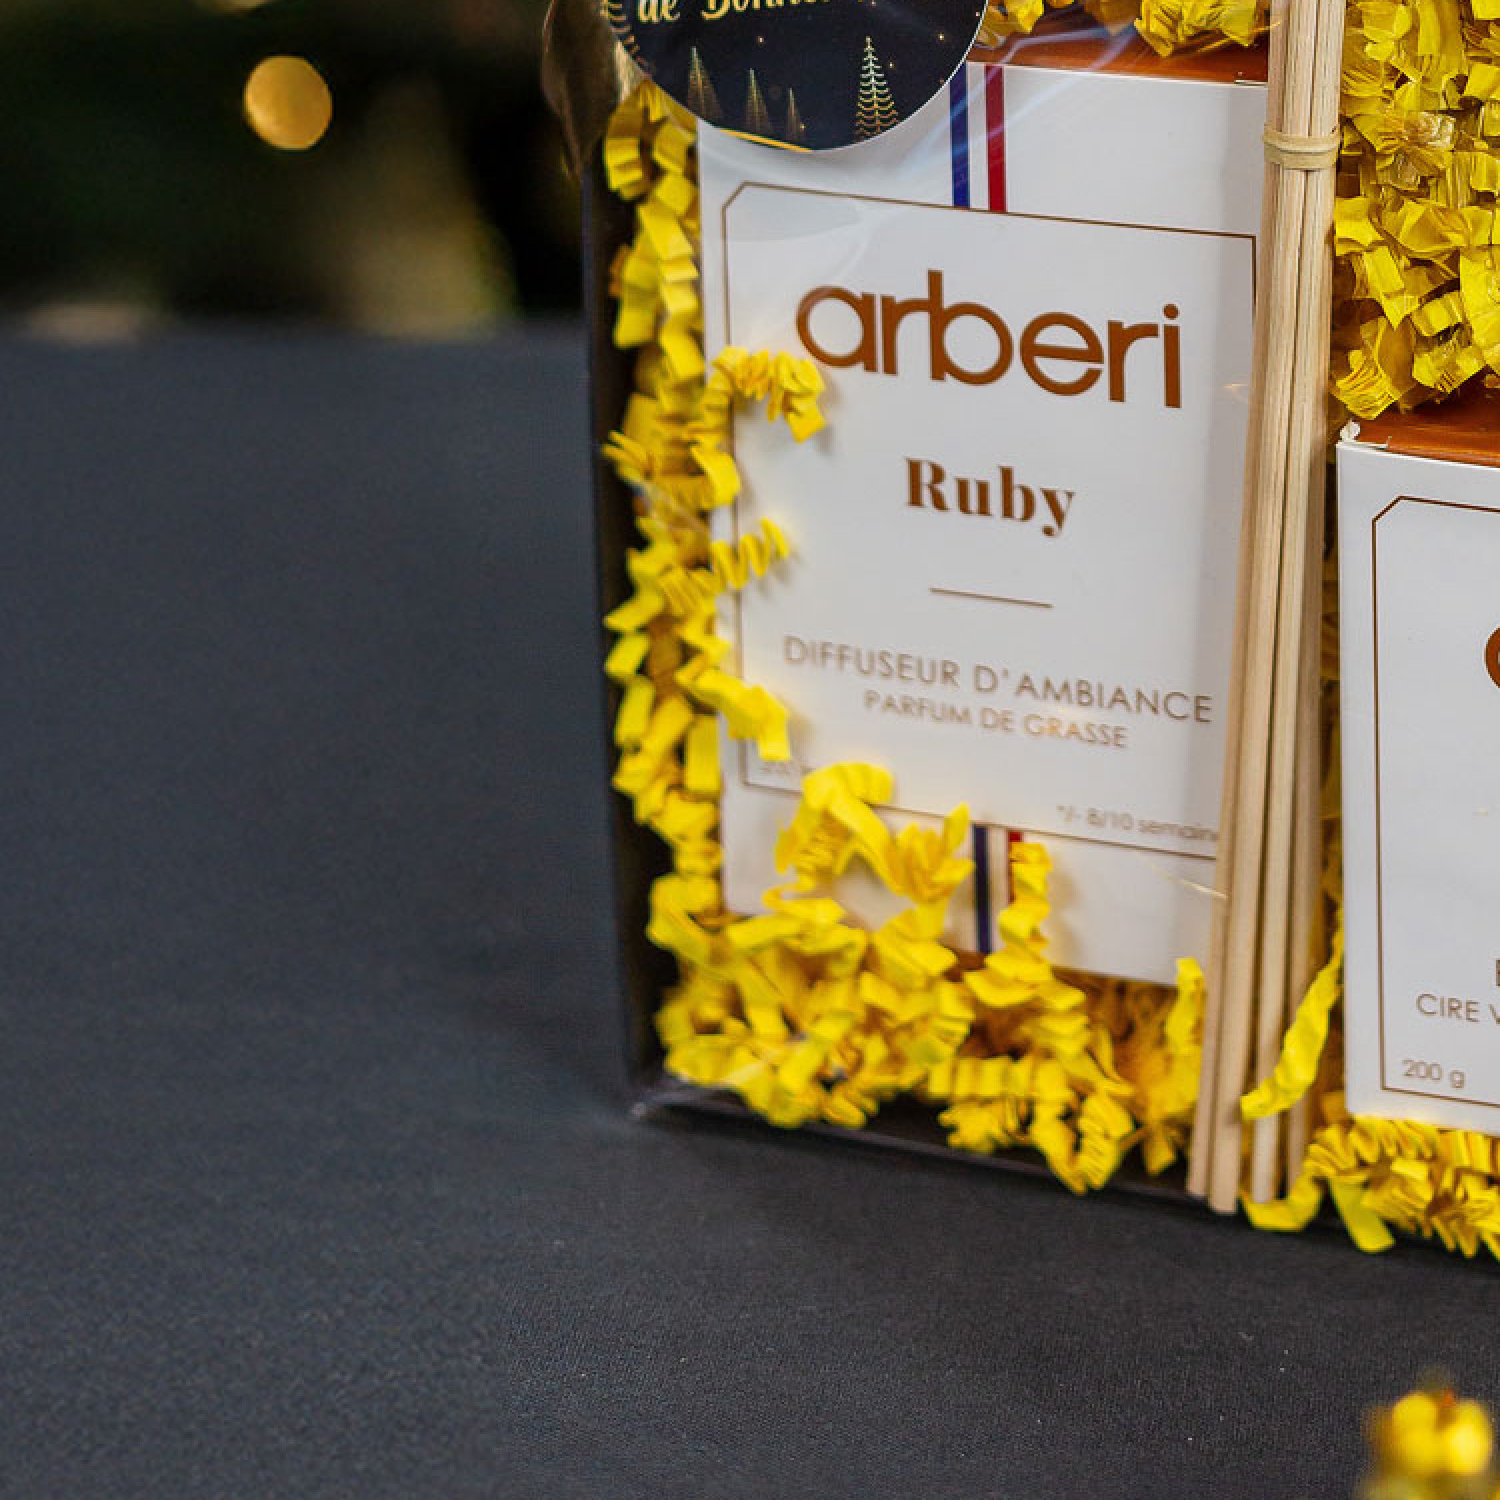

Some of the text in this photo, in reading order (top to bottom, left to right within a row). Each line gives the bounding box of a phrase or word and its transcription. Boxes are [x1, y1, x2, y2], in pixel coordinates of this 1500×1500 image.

[796, 269, 1182, 408] arberi
[905, 457, 1075, 537] Ruby
[783, 636, 1213, 724] DIFFUSEUR D'AMBIANCE
[864, 690, 1128, 749] PARFUM DE GRASSE
[1138, 819, 1218, 843] semain
[1415, 993, 1480, 1024] CIRE
[1401, 1058, 1466, 1090] 200 g
